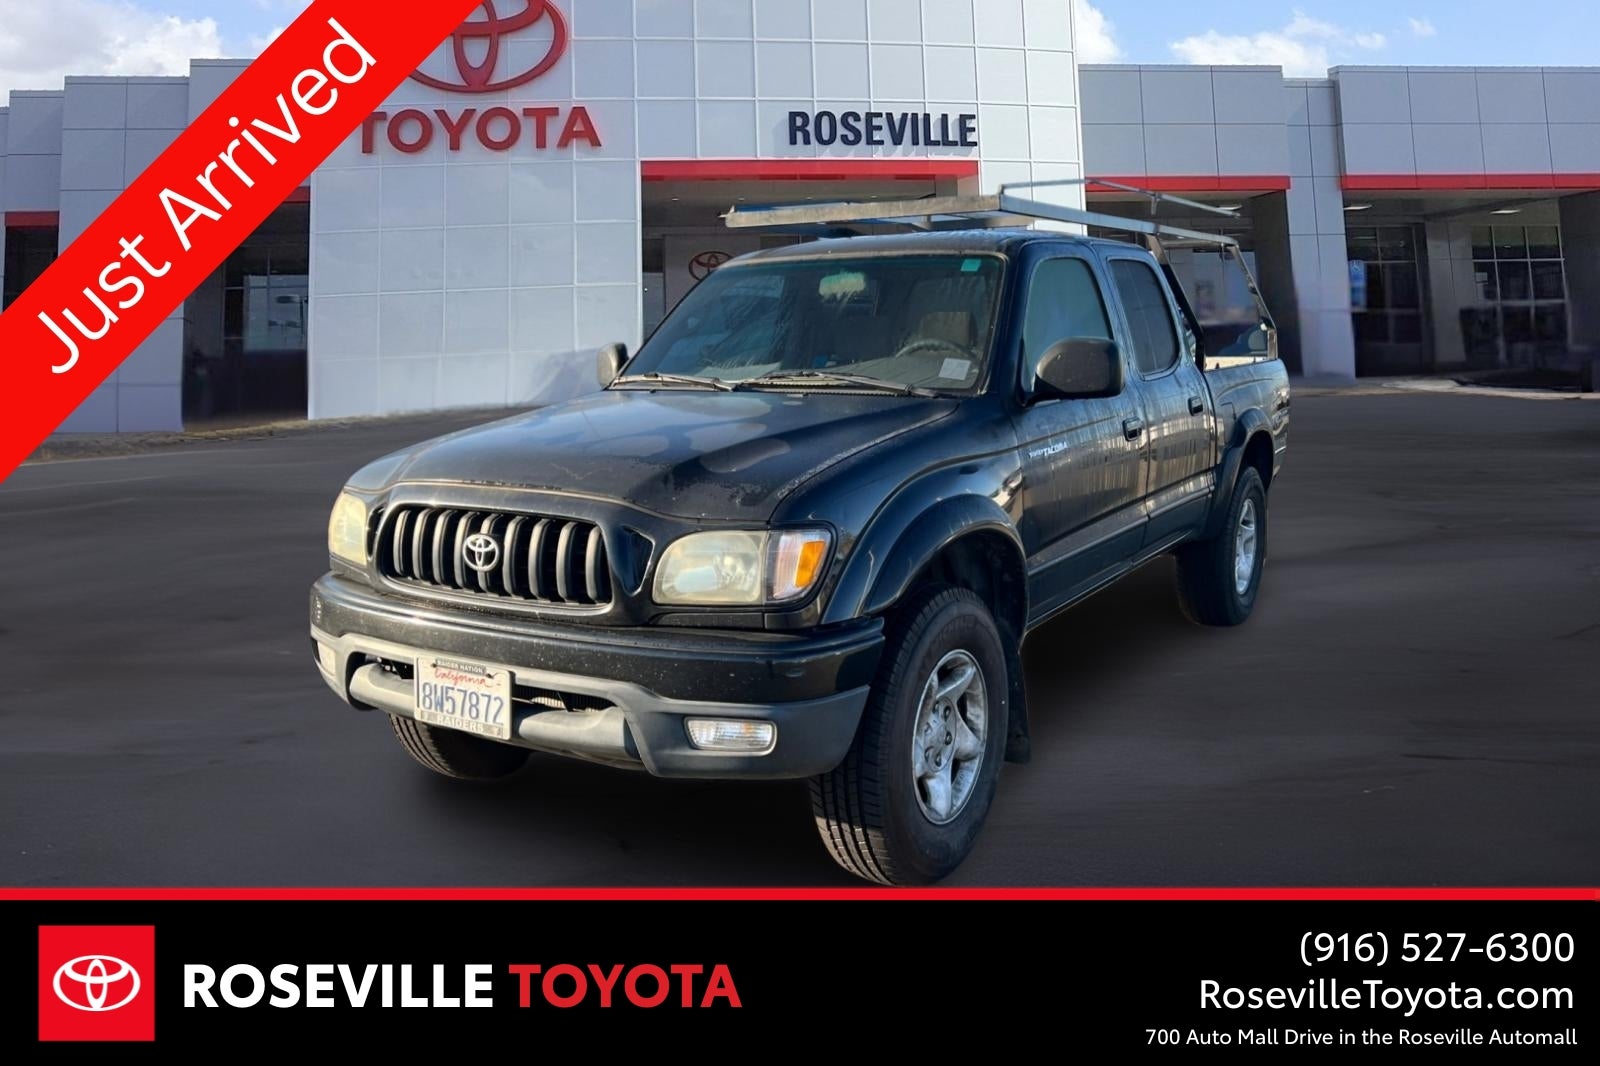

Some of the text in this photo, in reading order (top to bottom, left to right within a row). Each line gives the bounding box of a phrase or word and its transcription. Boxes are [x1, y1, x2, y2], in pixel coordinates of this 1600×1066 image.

[361, 107, 600, 154] TOYOTA
[788, 110, 978, 147] ROSEVILLE
[434, 667, 493, 688] California
[460, 663, 484, 674] NATION
[422, 682, 504, 725] 8W57872
